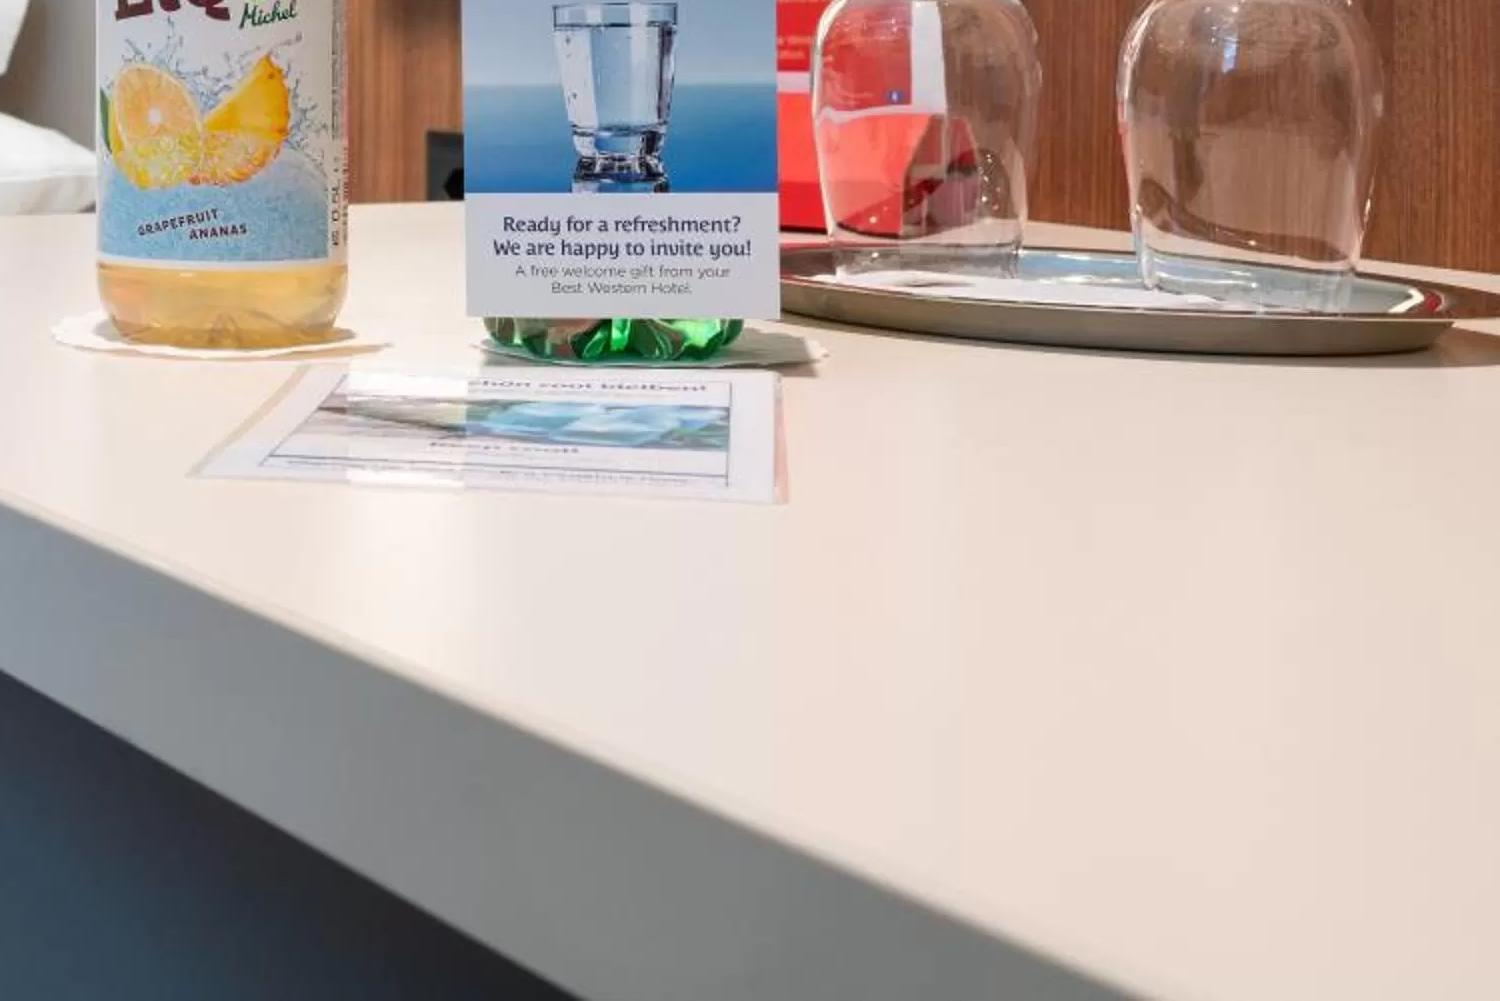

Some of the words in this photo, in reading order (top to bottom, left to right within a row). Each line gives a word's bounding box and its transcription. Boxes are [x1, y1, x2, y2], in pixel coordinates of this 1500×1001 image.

[138, 209, 219, 236] GRAPEFRUIT
[189, 223, 247, 240] ANANAS
[503, 216, 560, 236] Ready
[566, 215, 593, 232] for
[597, 219, 609, 232] a
[613, 215, 741, 233] refreshment?
[493, 239, 521, 256] We
[526, 241, 555, 256] are
[561, 239, 619, 259] happy
[625, 241, 645, 256] to
[650, 239, 704, 256] invite
[709, 239, 751, 260] you!
[515, 264, 526, 276] A
[530, 264, 558, 277] free
[561, 265, 626, 278] welcome
[629, 264, 654, 279] gift
[659, 264, 693, 278] from
[698, 266, 731, 280] your
[551, 282, 582, 294] Best
[587, 282, 647, 294] Western
